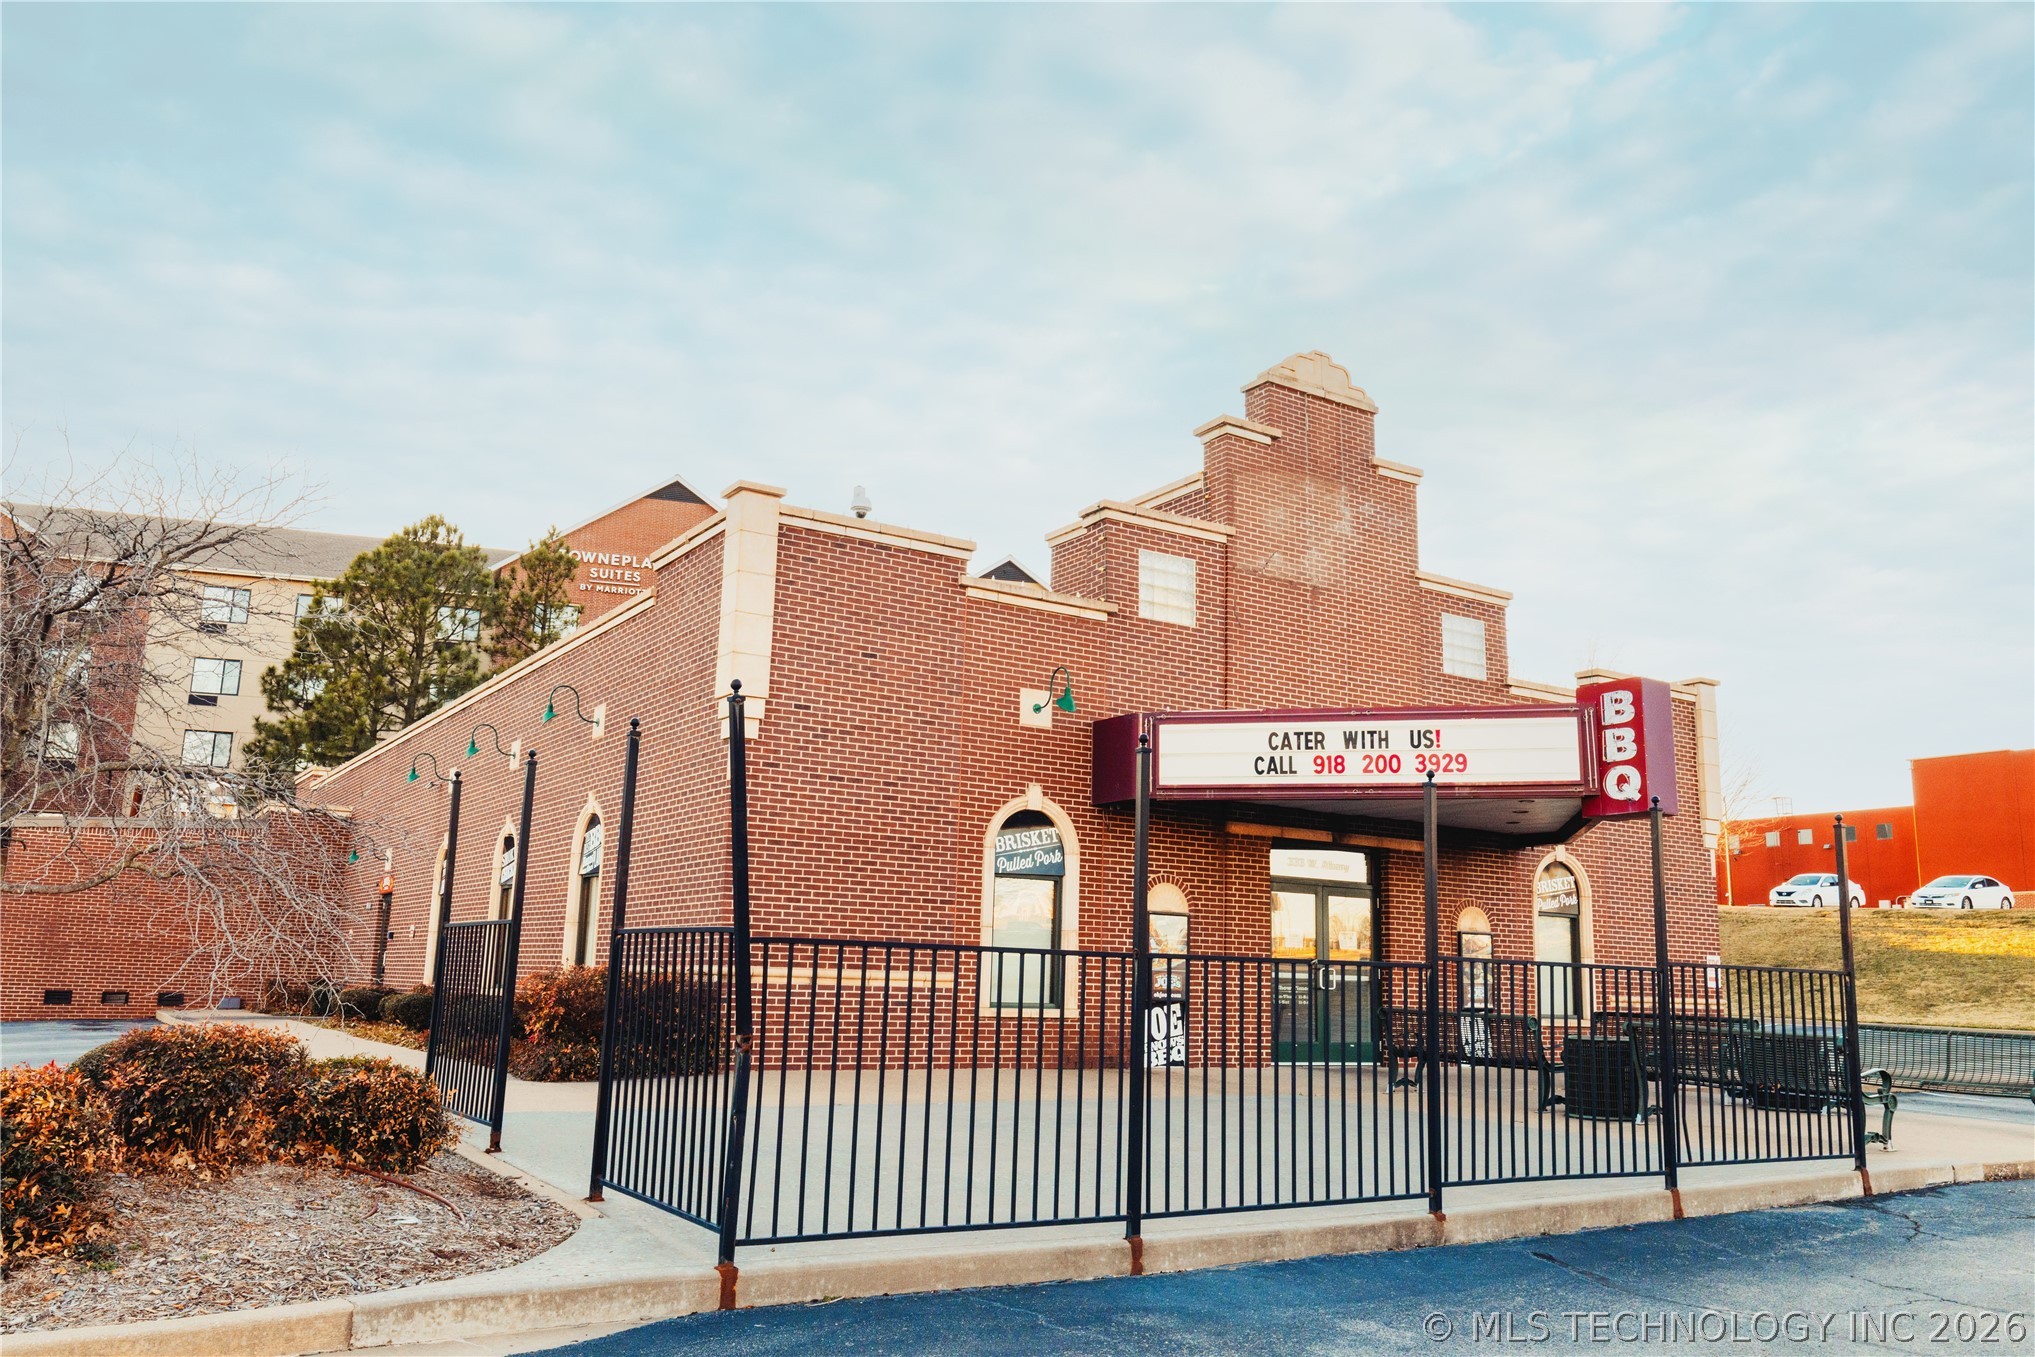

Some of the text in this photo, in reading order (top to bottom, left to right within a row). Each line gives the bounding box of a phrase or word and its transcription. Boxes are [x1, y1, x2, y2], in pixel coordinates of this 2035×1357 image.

[589, 567, 641, 582] SUITES
[579, 583, 592, 591] BY
[1268, 729, 1441, 751] CATER WITH US!
[1600, 690, 1642, 801] BBQ
[1254, 753, 1468, 775] CALL 918 200 3929
[995, 828, 1059, 852] BRISKET
[996, 849, 1063, 873] Pulled Pork
